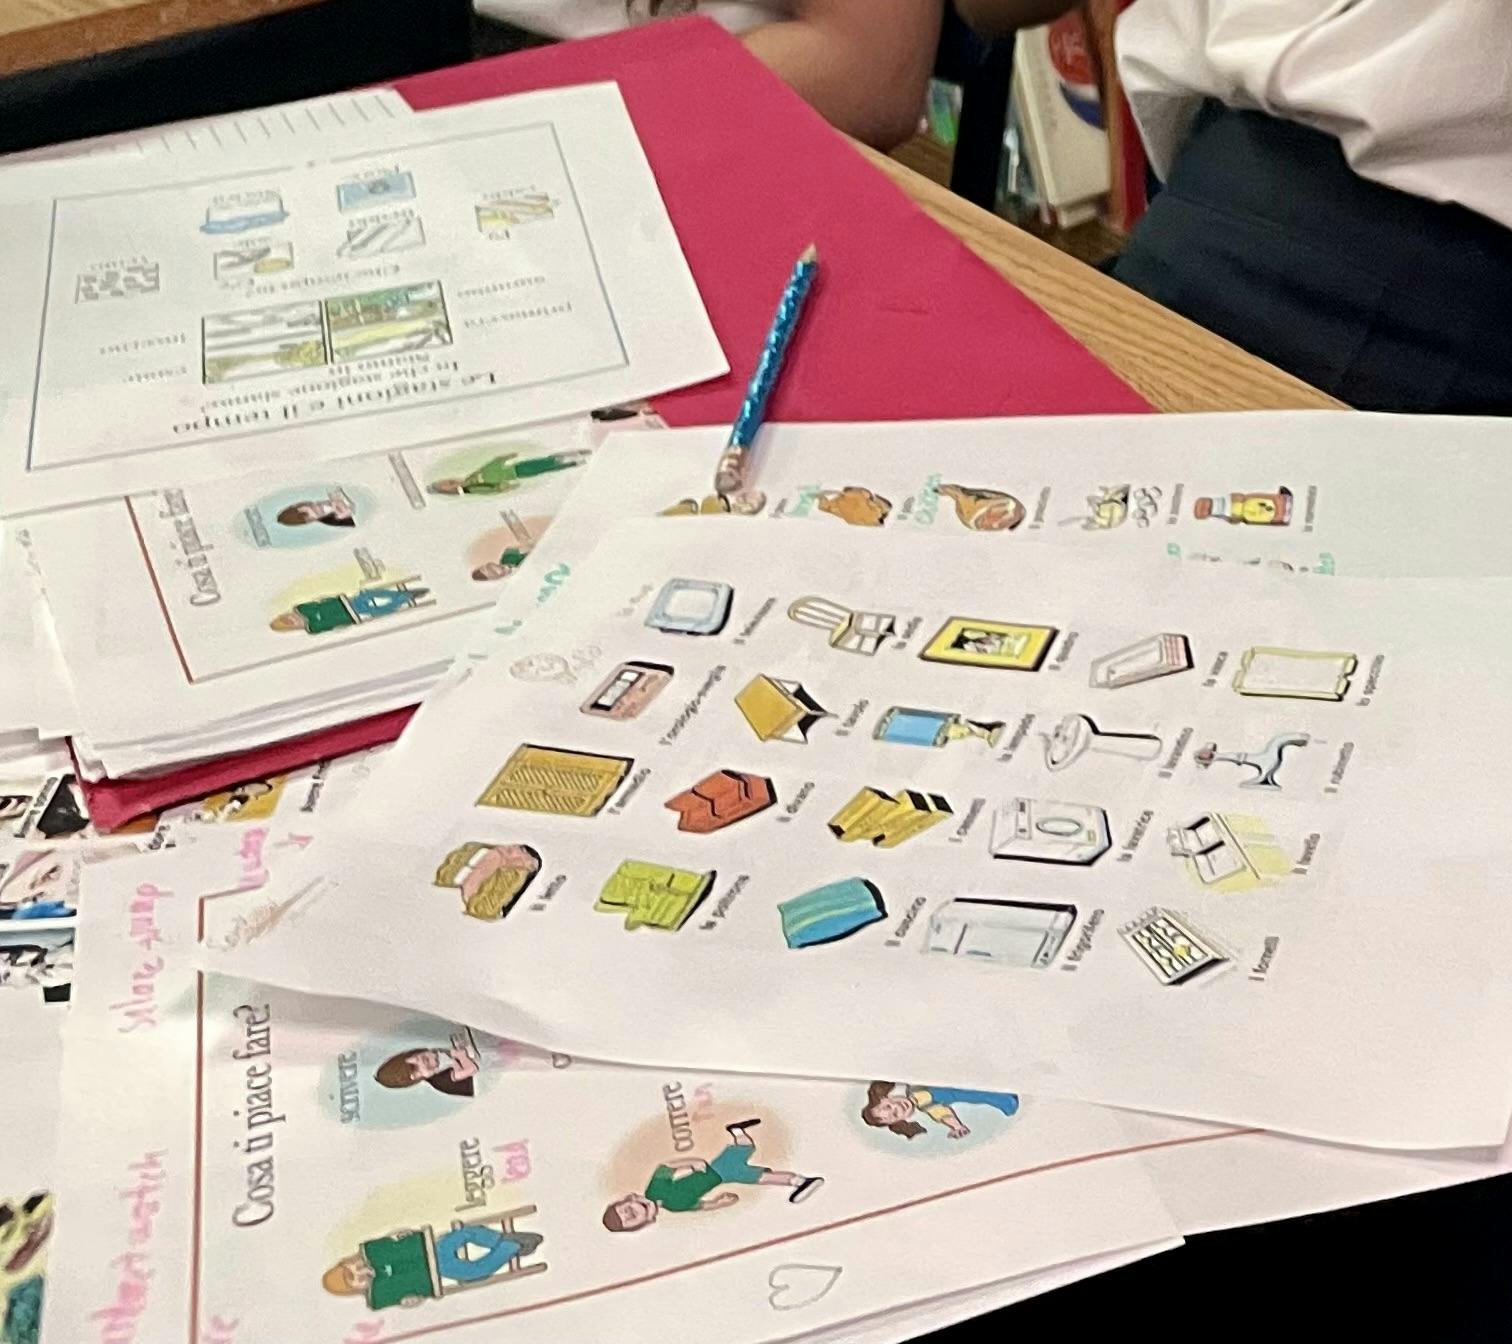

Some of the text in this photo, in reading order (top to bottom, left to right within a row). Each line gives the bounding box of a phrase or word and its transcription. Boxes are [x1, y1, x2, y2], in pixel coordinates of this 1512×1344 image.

[232, 1004, 286, 1229] Cosa ti piace fare?
[329, 1050, 361, 1125] scrivere
[662, 1080, 695, 1153] correre
[454, 1137, 496, 1212] leggere
